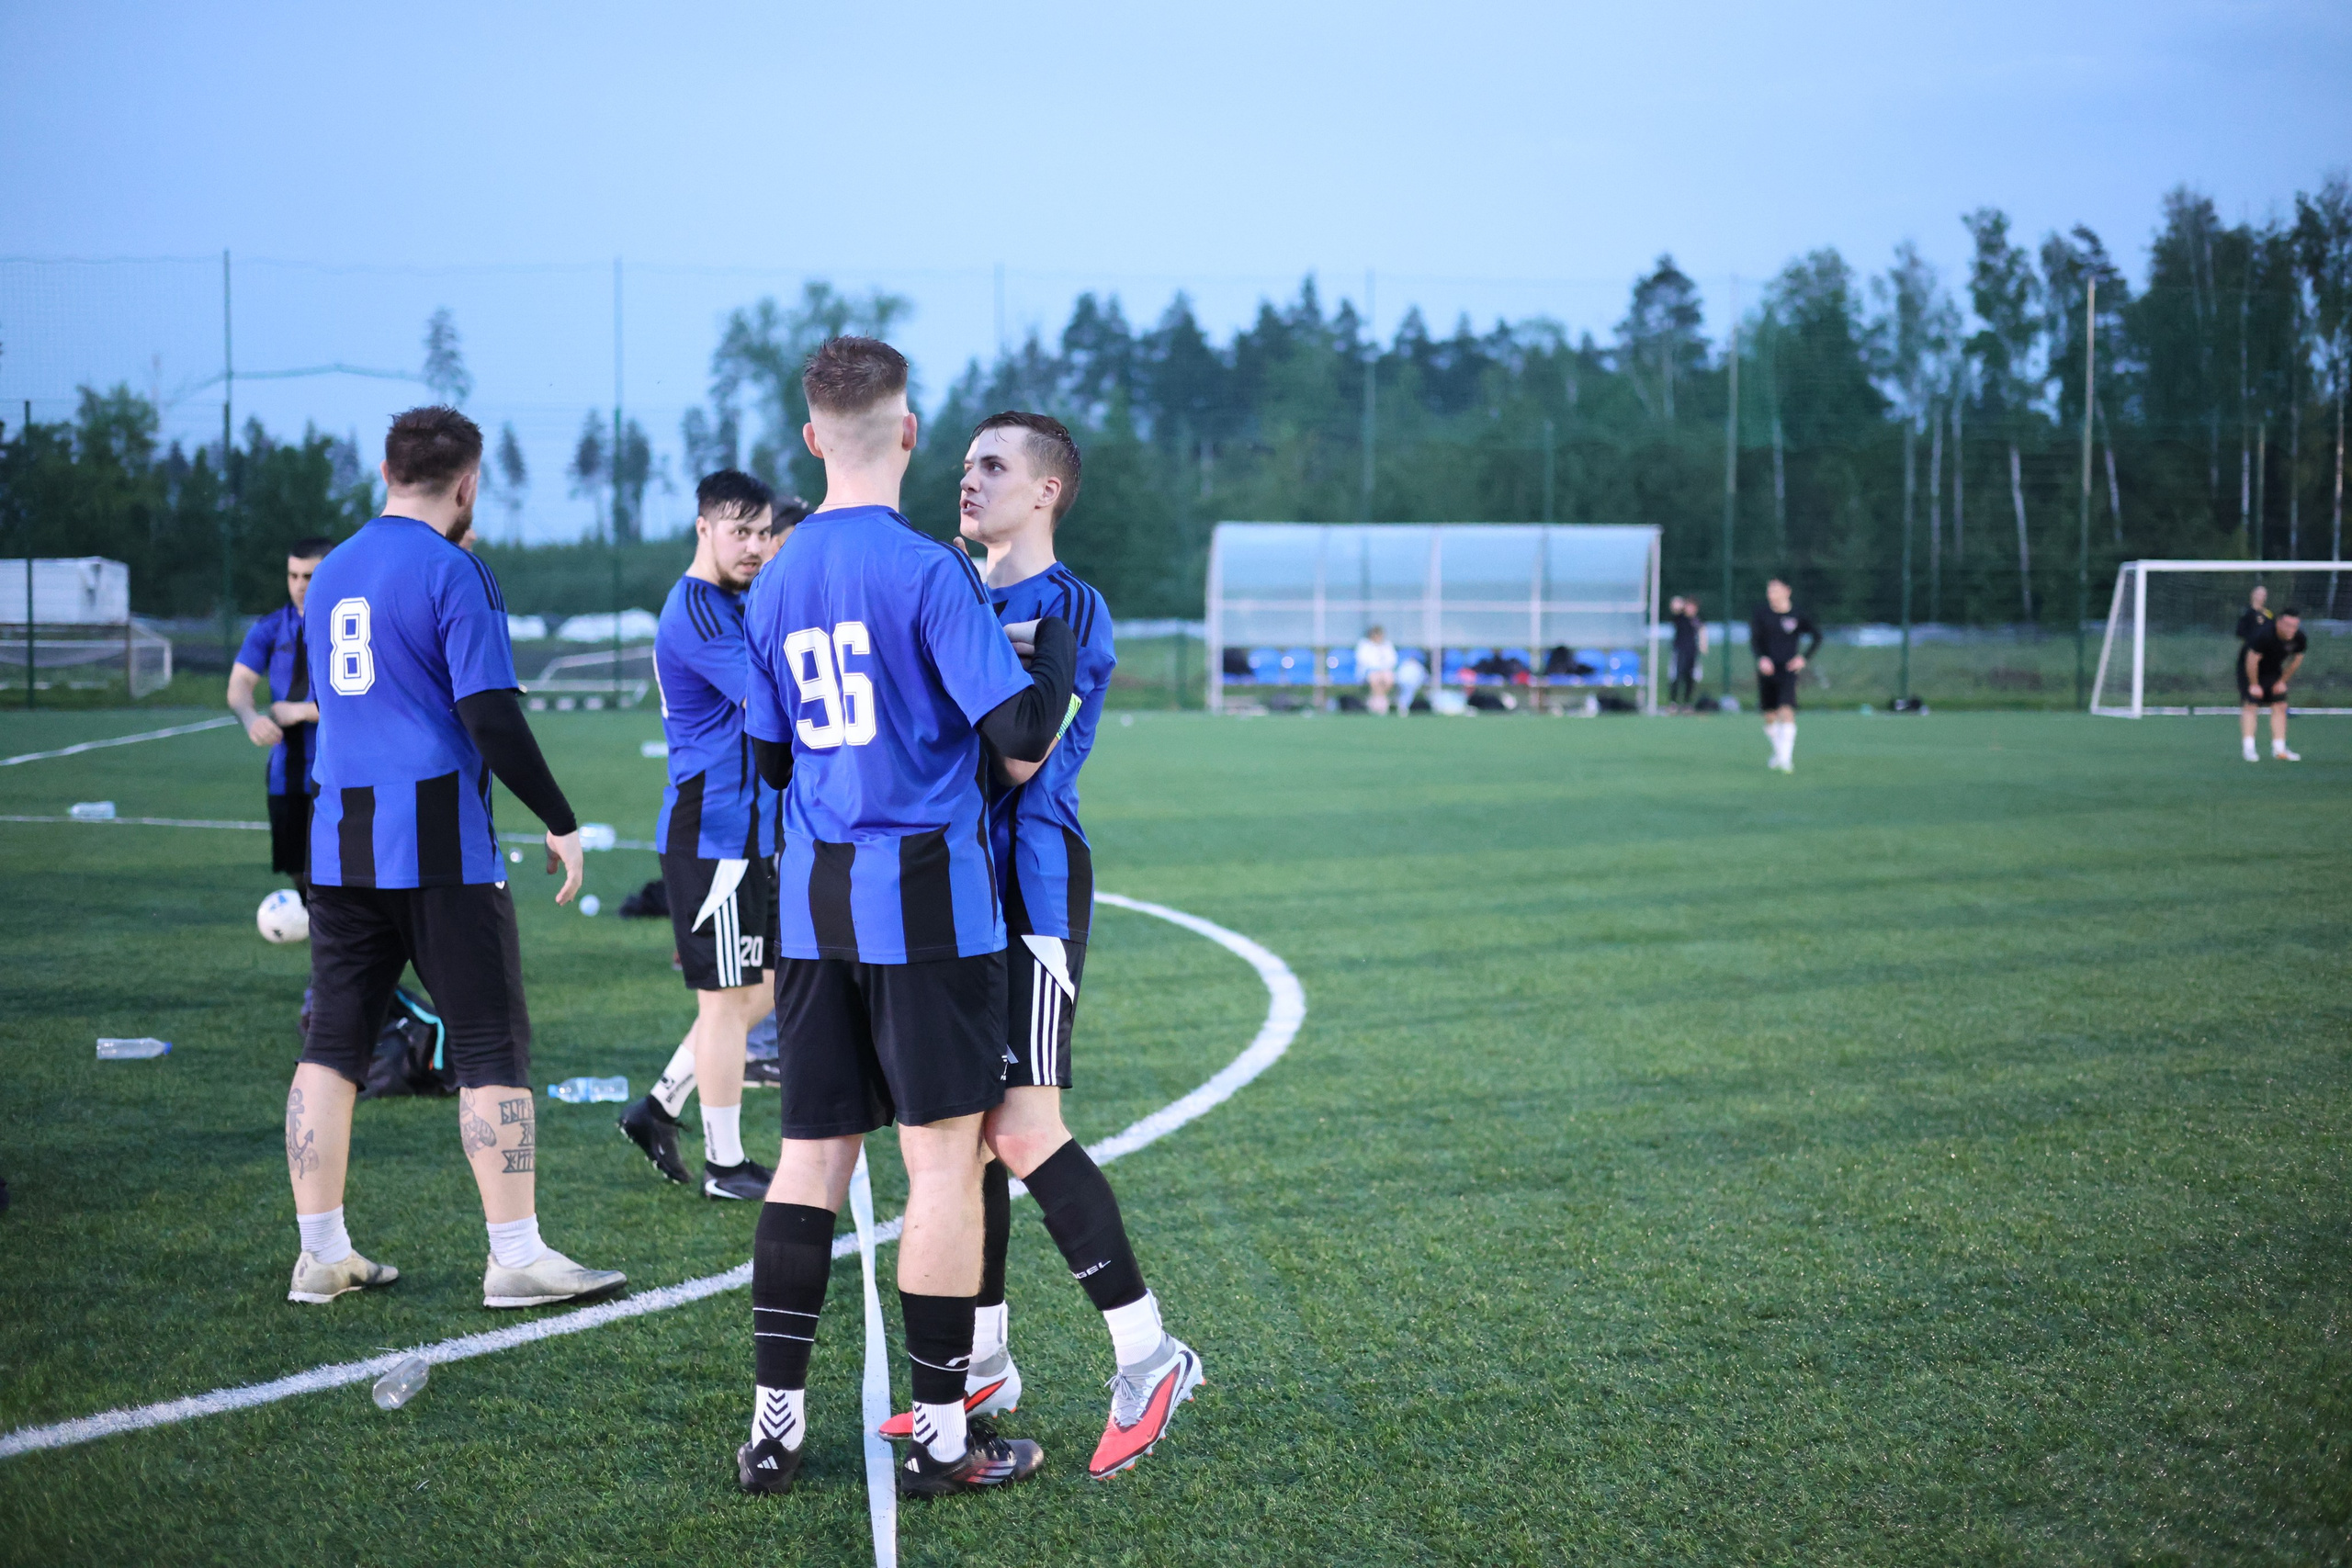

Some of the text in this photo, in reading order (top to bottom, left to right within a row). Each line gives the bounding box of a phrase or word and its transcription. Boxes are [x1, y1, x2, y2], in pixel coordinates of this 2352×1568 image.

[330, 596, 376, 696] 8
[783, 621, 877, 750] 96
[740, 935, 763, 967] 20
